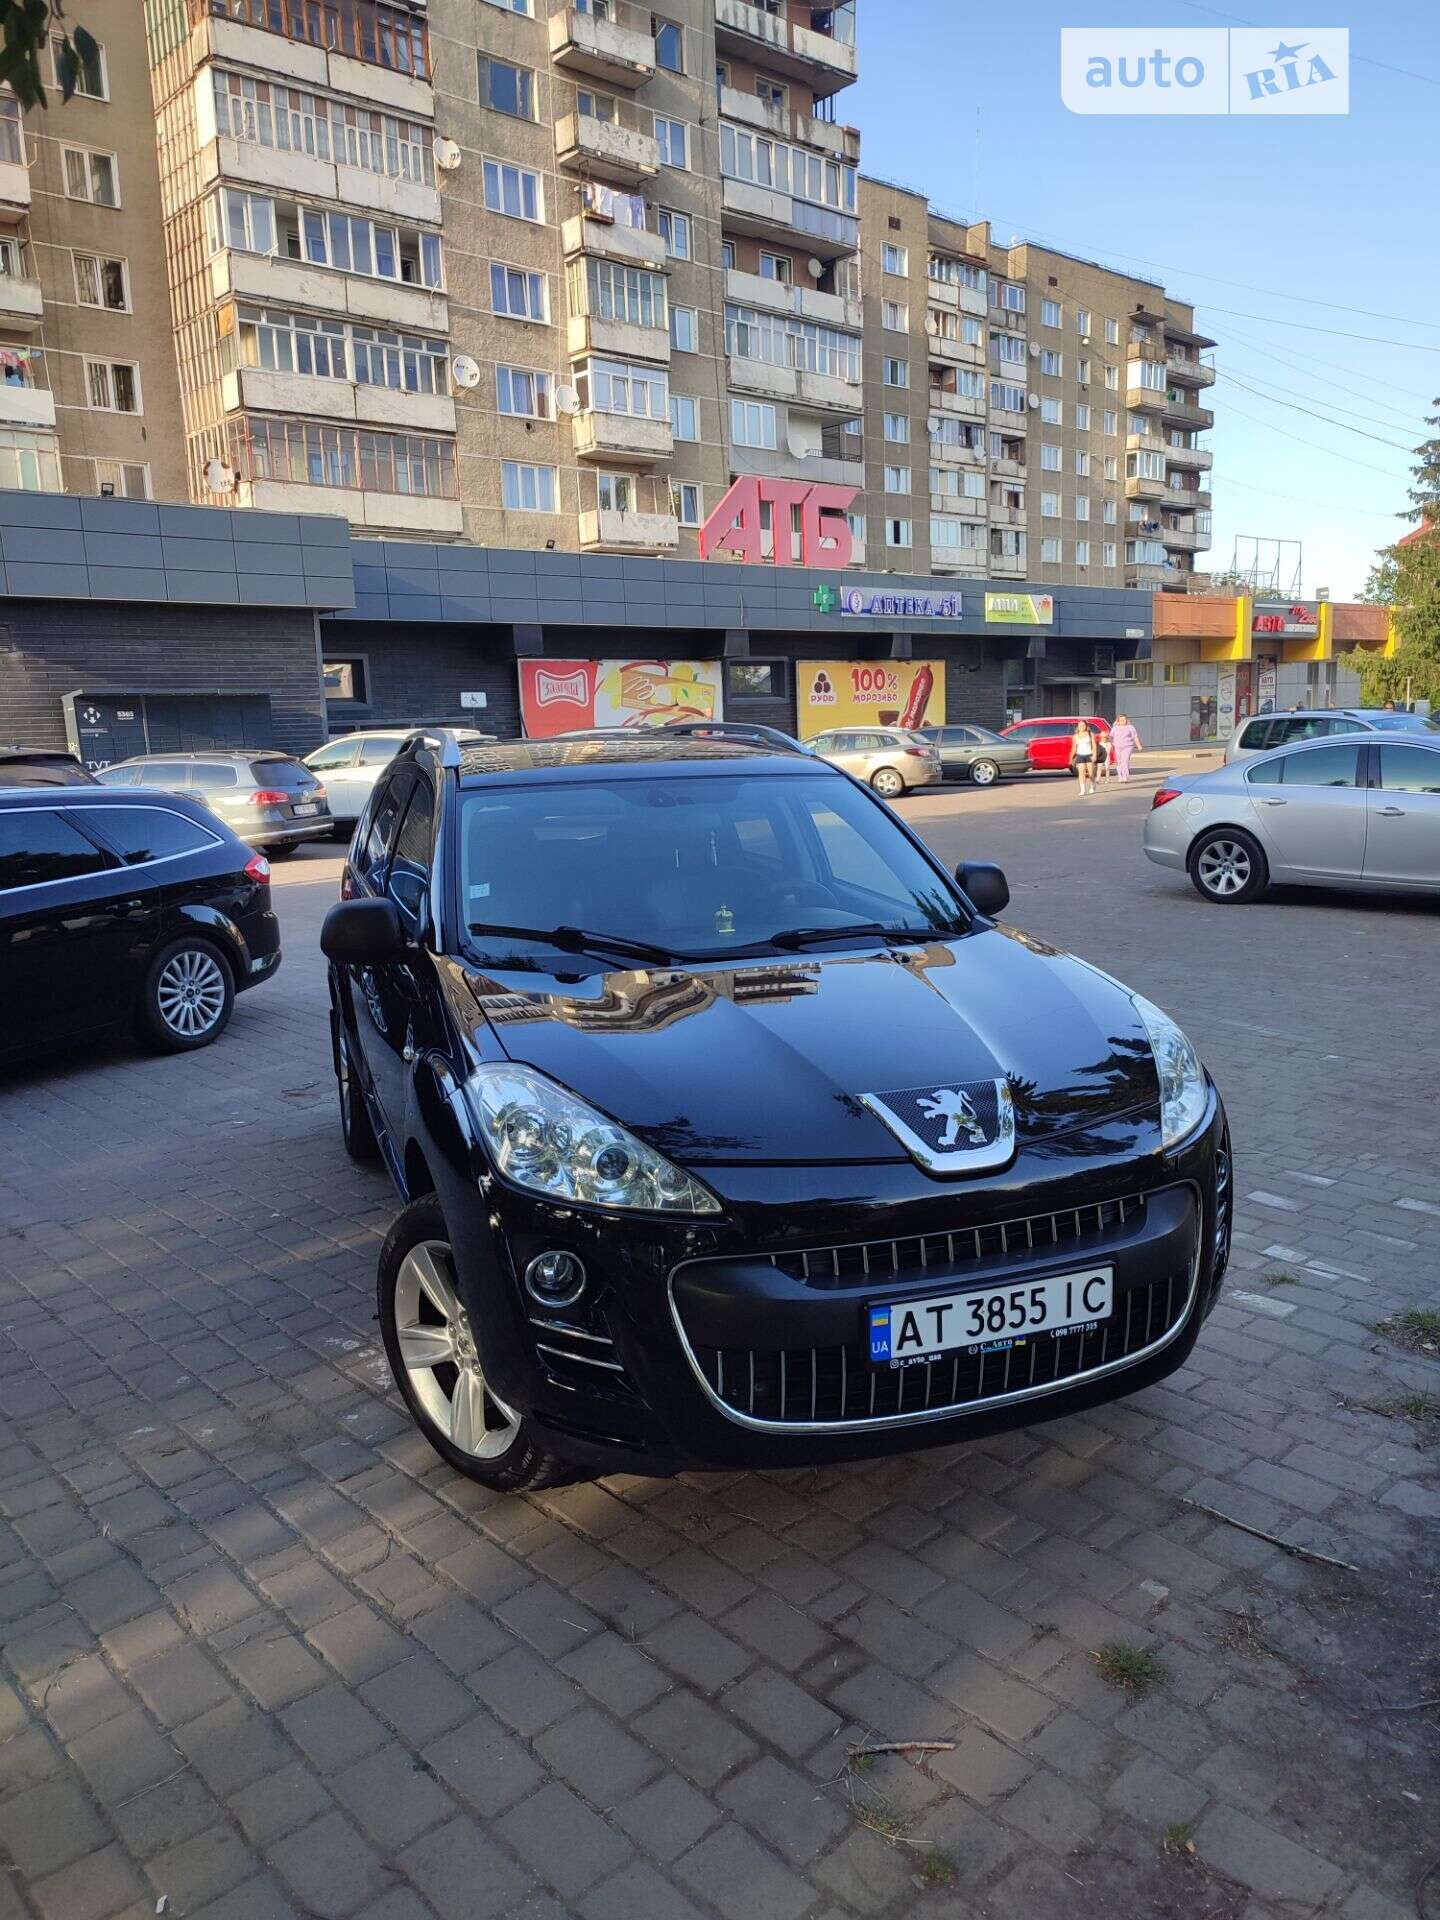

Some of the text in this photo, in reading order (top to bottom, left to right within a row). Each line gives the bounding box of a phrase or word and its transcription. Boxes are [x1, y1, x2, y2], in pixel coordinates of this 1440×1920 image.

[698, 475, 859, 567] АТБ
[870, 595, 936, 615] АПТЕКА
[852, 693, 898, 703] МОРОЗИВО
[896, 1276, 1107, 1351] AT 3855 IC
[871, 1341, 889, 1353] UA
